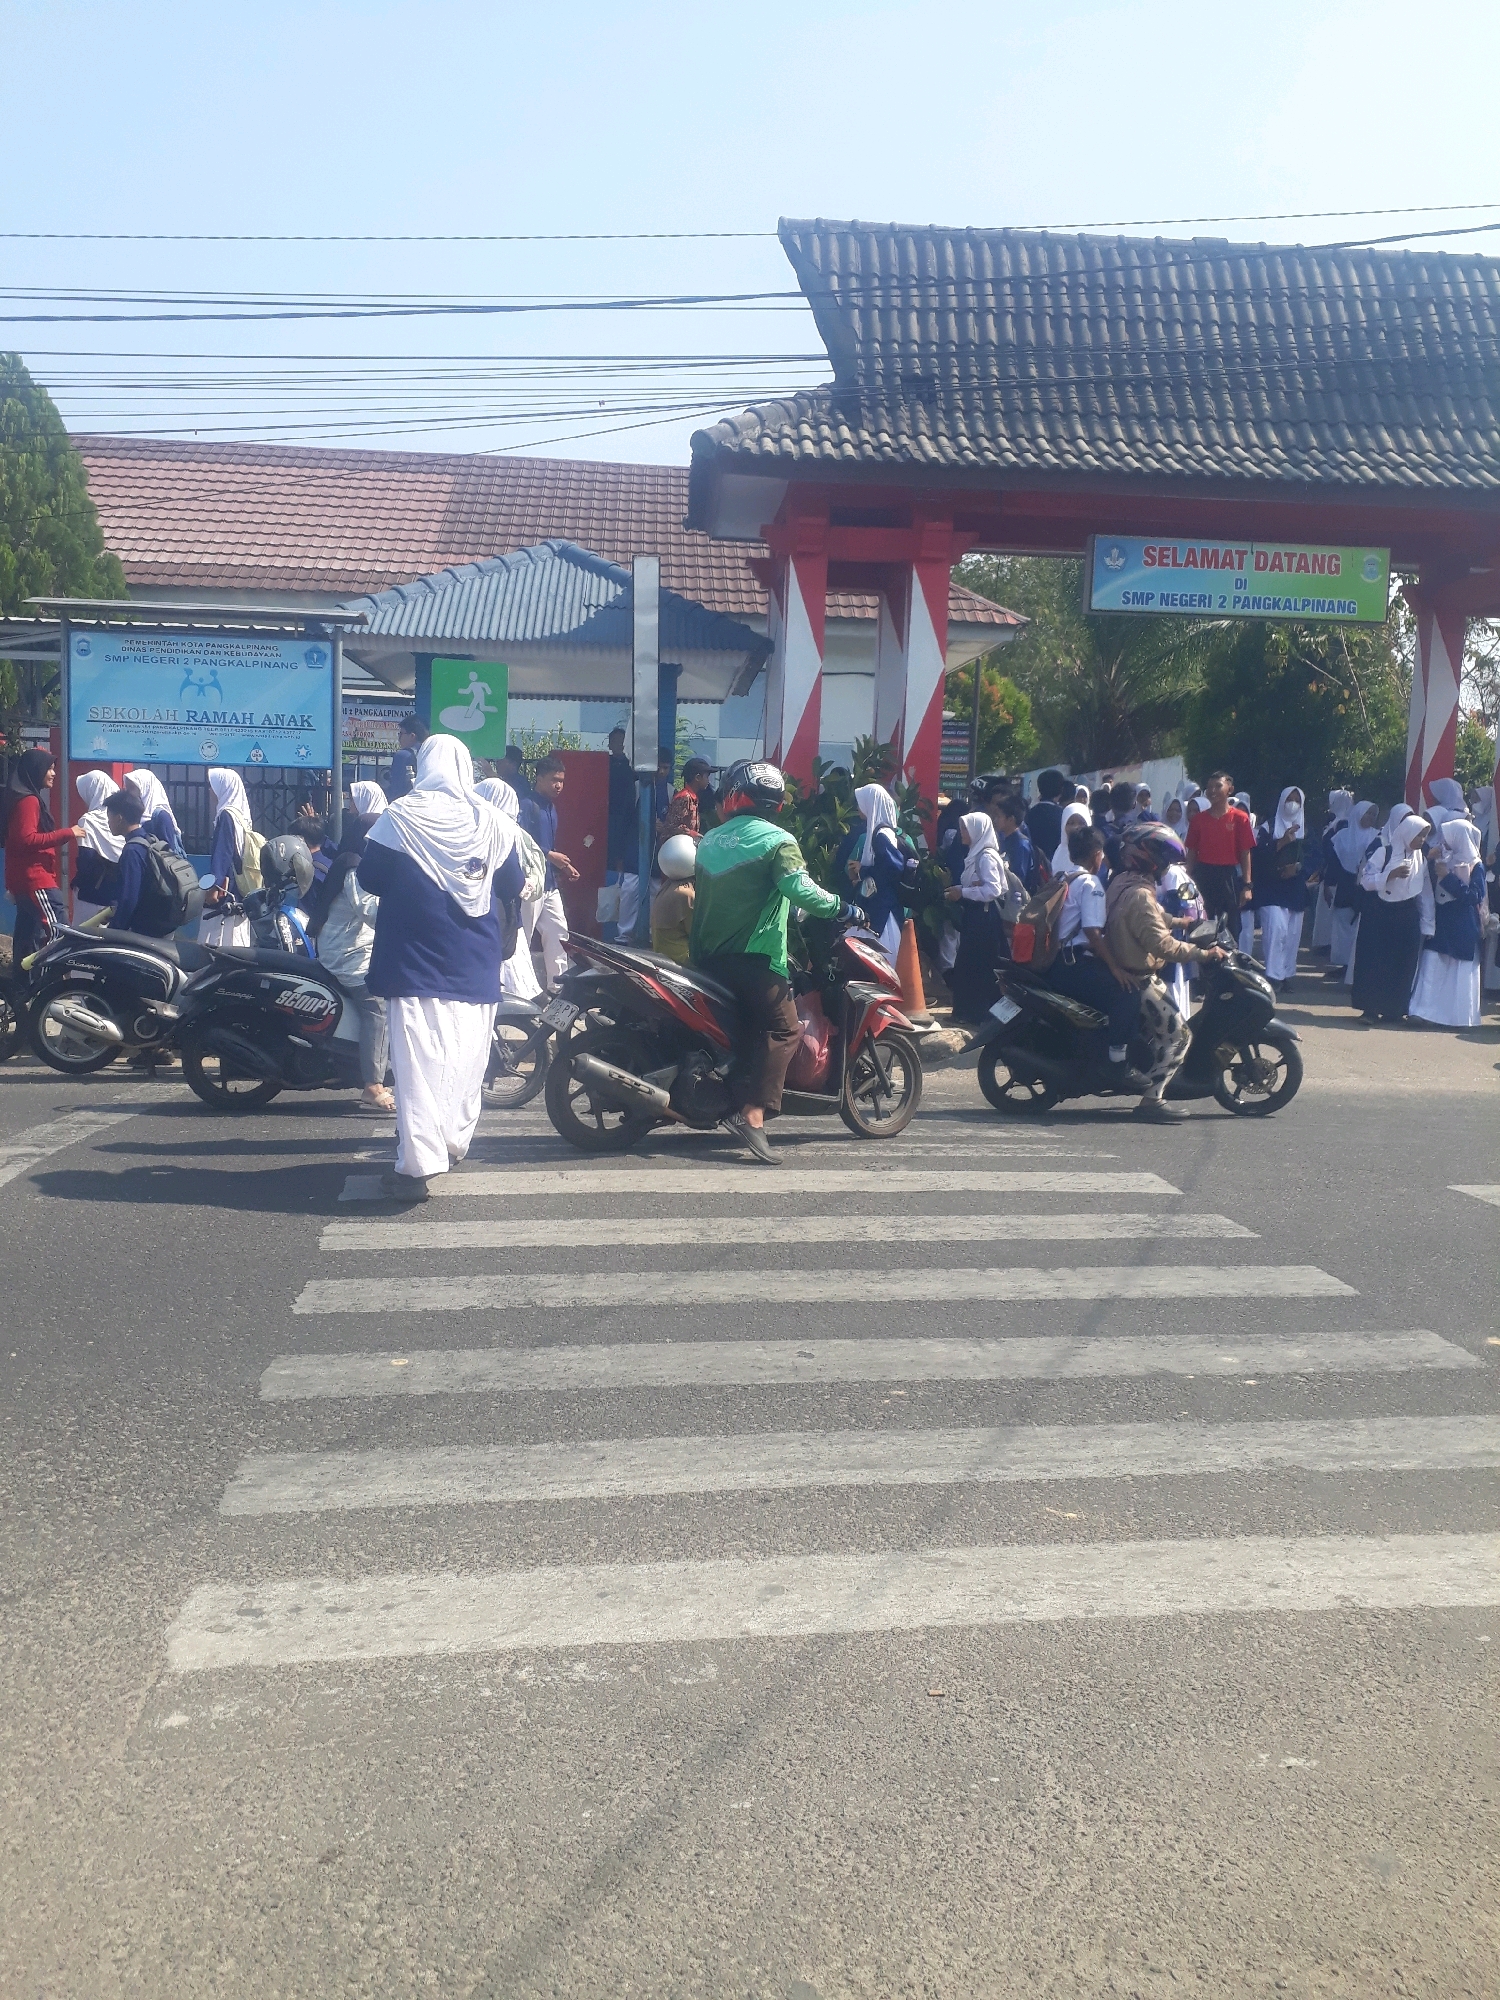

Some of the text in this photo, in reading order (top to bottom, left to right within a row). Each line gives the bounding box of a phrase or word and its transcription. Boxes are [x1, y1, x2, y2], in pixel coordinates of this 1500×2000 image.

[1142, 545, 1341, 576] SELAMAT DATANG
[1234, 578, 1248, 591] DI
[1121, 590, 1357, 614] SMP NEGERI 2 PANGKALPINANG
[124, 639, 178, 647] PEMERINTAH
[205, 642, 279, 652] PANGKALPINANG
[149, 647, 202, 655] PENDIDIKAN
[223, 650, 282, 658] KEBUDAYAAN
[104, 654, 299, 670] SMP NEGERI 2 PANGKALPINANG
[89, 706, 314, 728] SEKOLAH RAMAH ANAK
[623, 971, 665, 1000] 125
[274, 989, 339, 1016] SCOOPY
